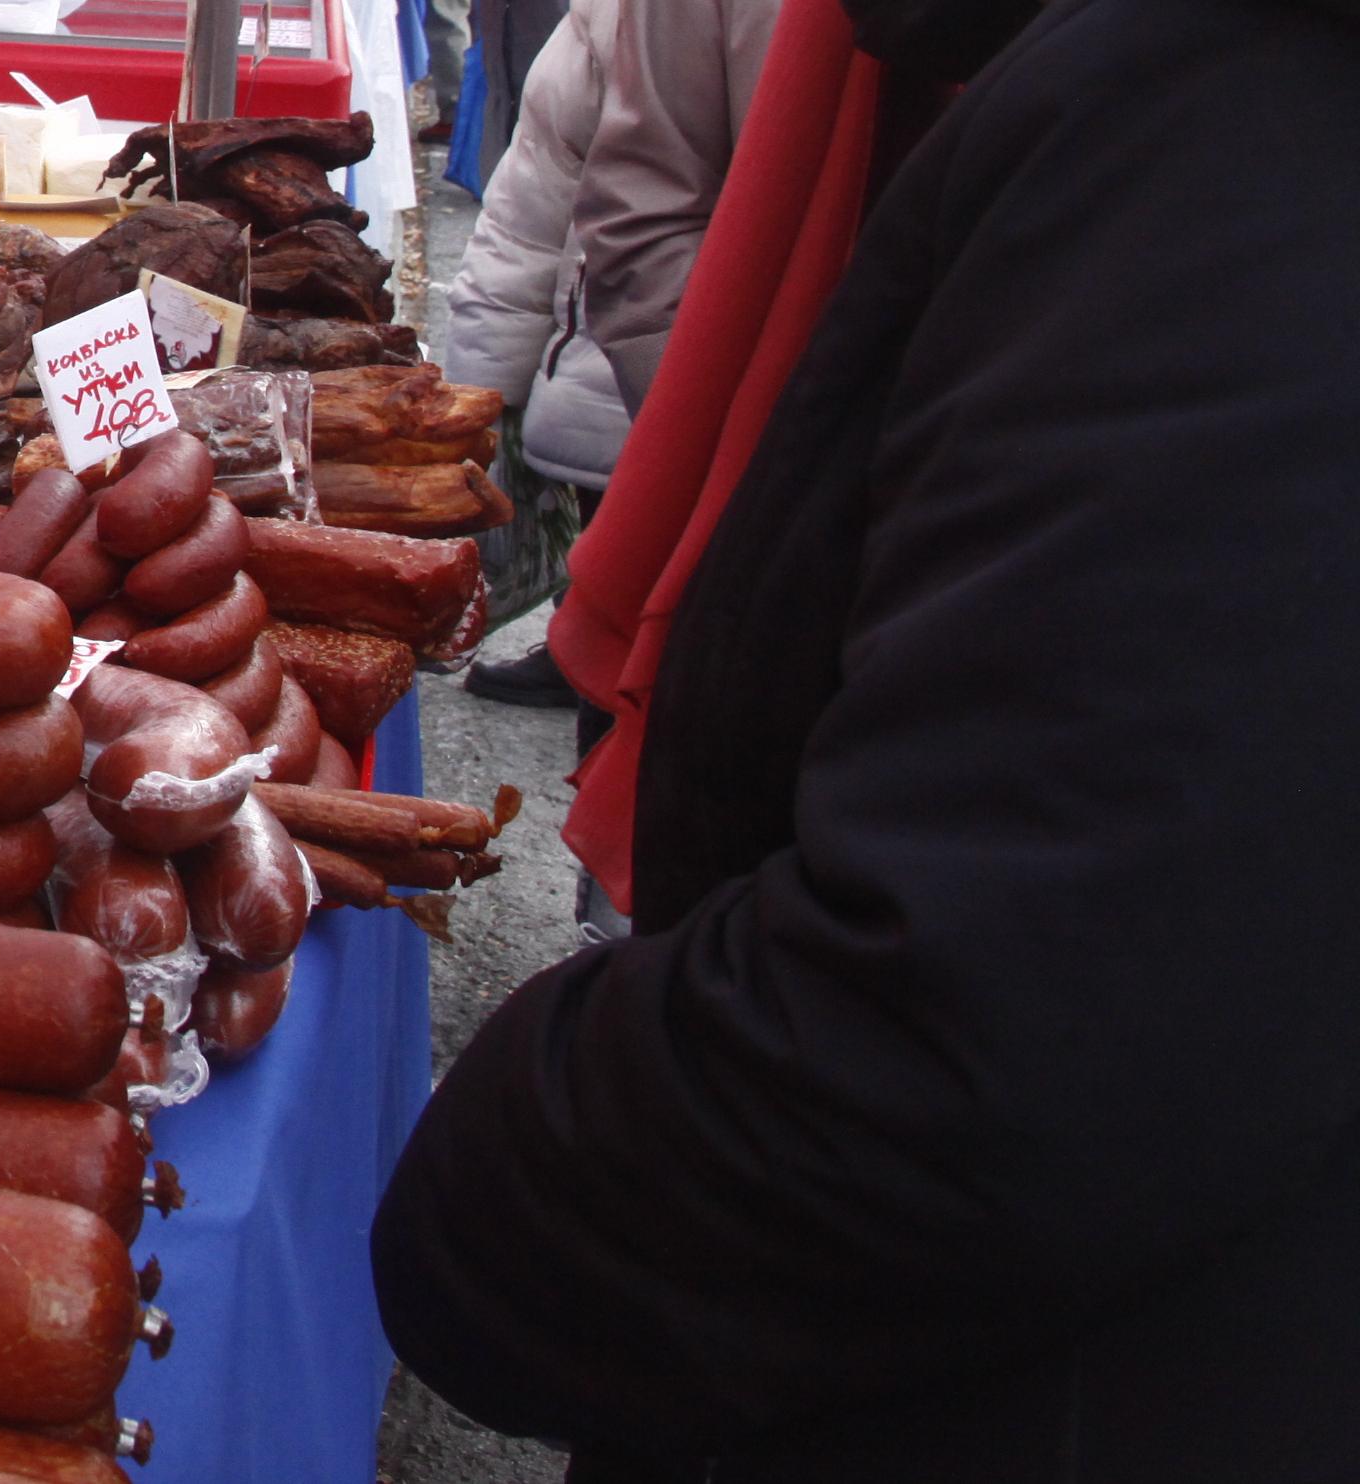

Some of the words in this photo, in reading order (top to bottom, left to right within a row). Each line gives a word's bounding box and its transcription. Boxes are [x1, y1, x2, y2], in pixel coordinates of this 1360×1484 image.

[47, 322, 140, 377] КОЛБАСКА
[79, 361, 105, 382] ИЗ
[62, 361, 145, 415] УТКИ
